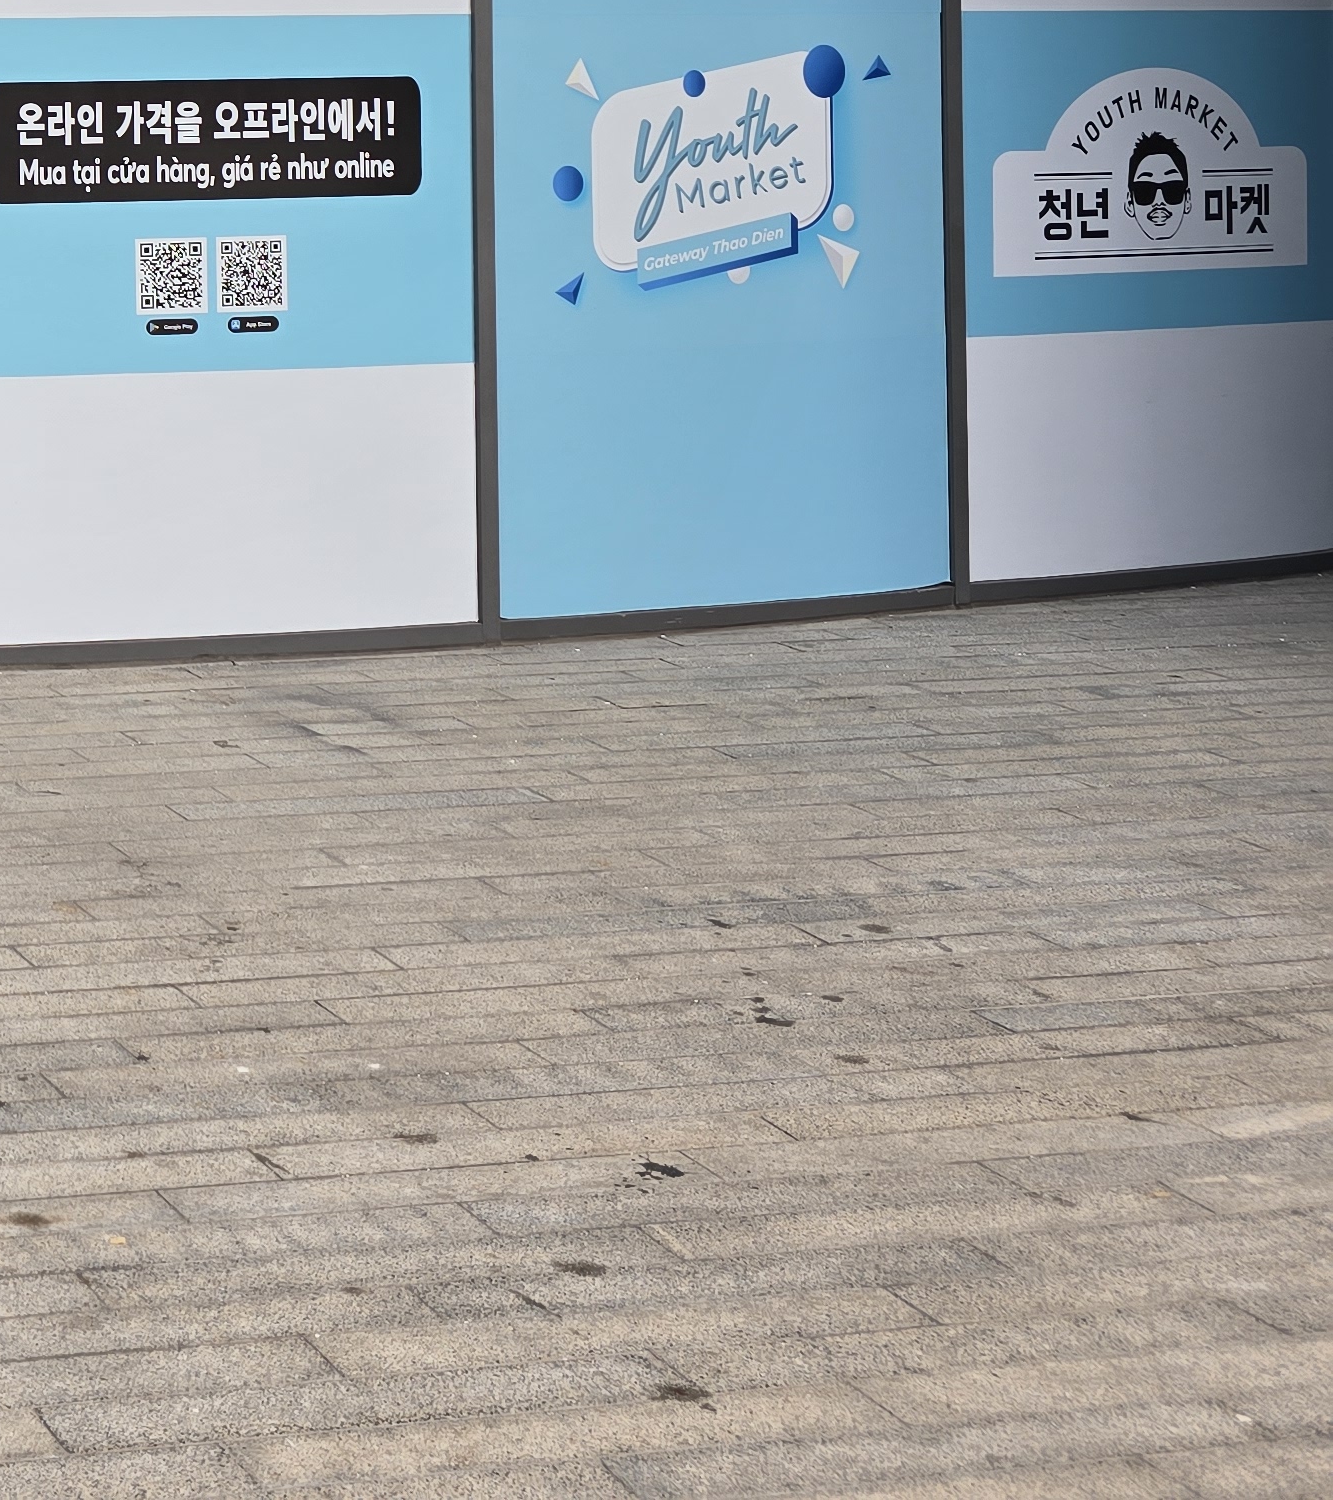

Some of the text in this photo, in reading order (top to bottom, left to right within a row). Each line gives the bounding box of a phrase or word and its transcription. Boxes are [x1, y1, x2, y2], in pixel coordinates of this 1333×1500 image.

[16, 98, 396, 146] 온라인 가격을 오프라인에서!
[1070, 86, 1240, 156] YOUTH MARKET
[19, 152, 395, 192] Mua tại cửa hàng, giá rẻ như online
[632, 86, 797, 242] Youth
[674, 156, 807, 214] Market
[1038, 184, 1271, 240] 청년 마켓
[642, 226, 785, 273] Gateway Thao Dien
